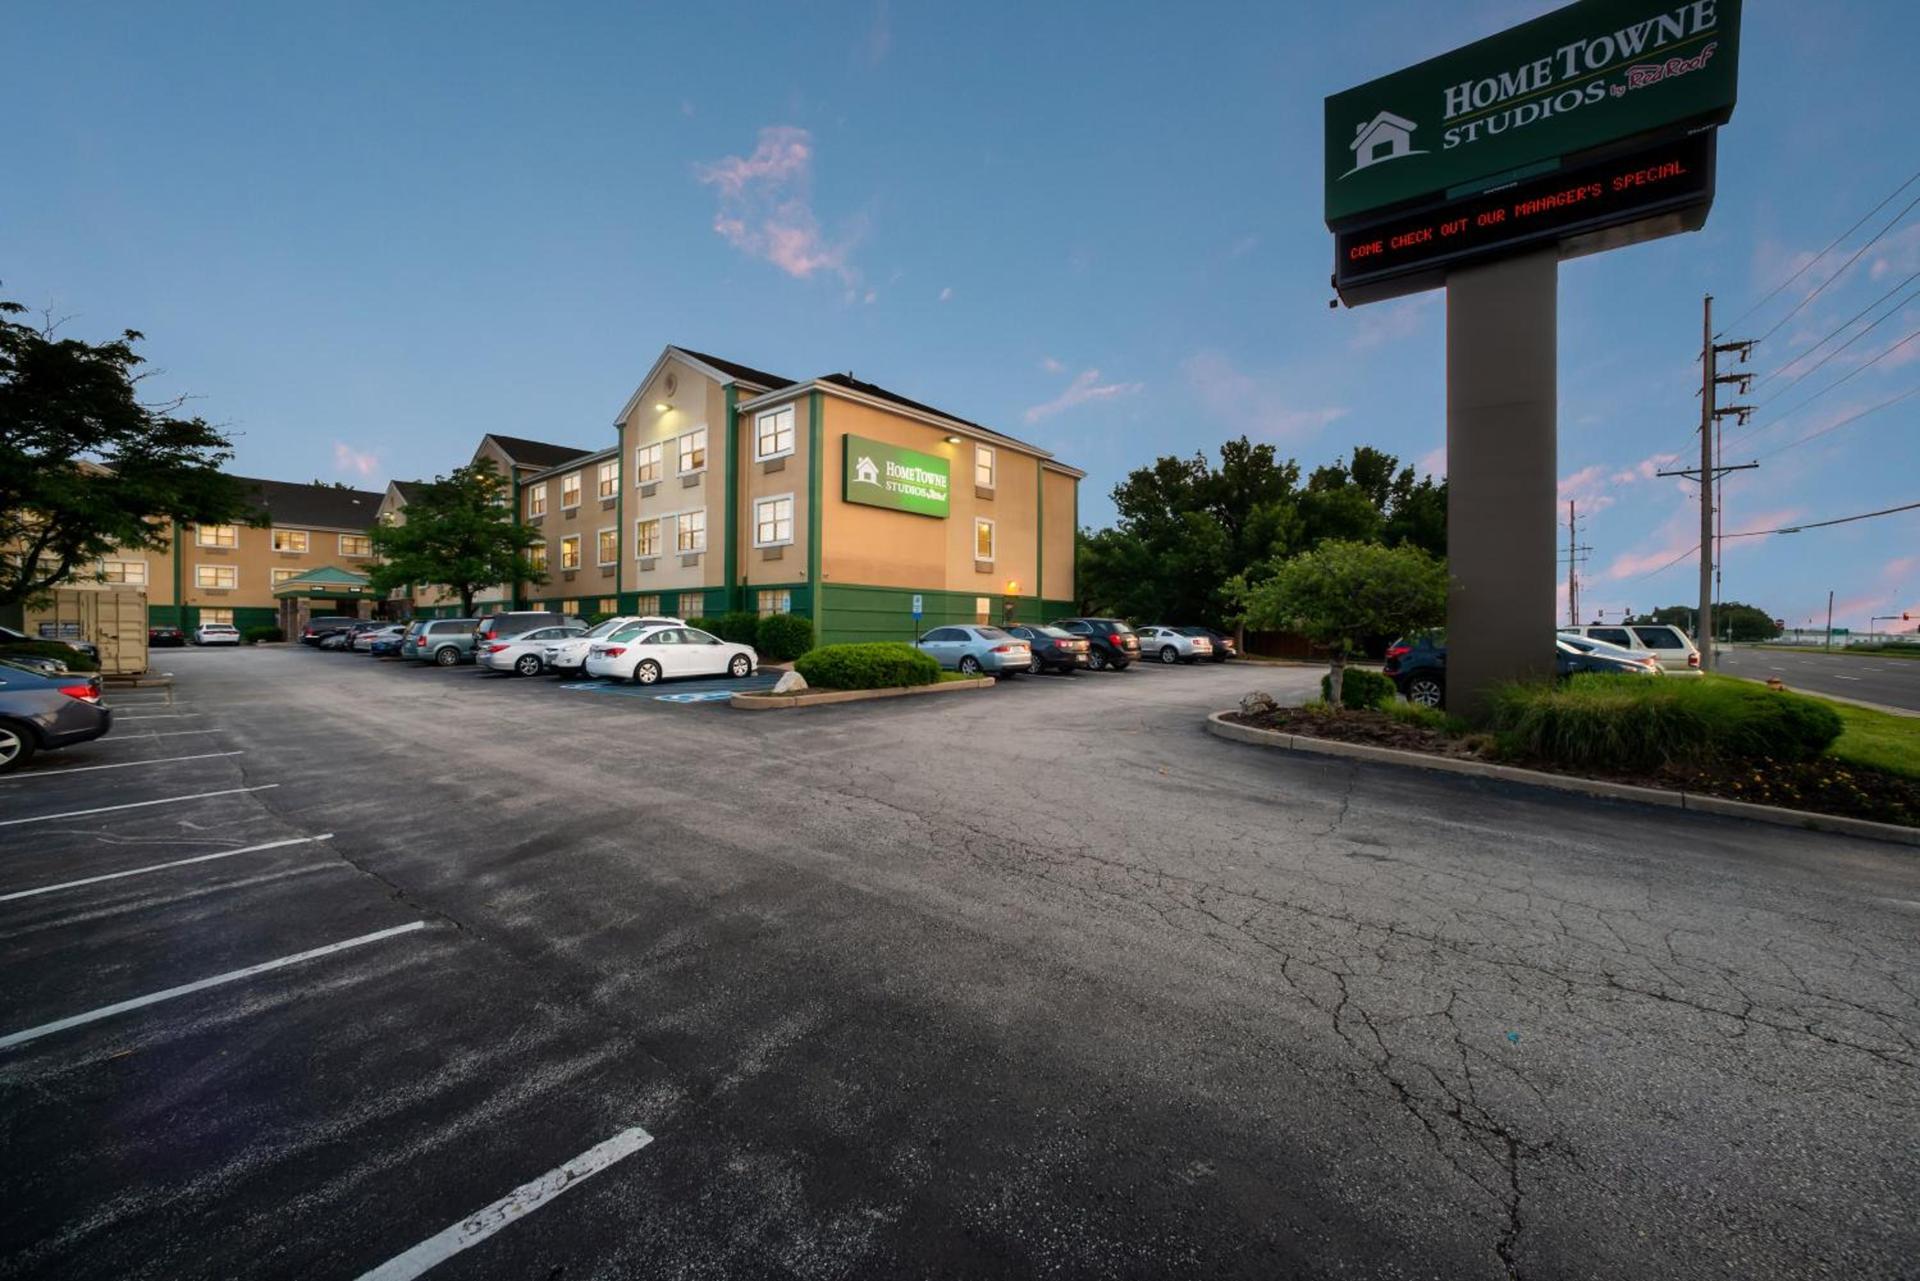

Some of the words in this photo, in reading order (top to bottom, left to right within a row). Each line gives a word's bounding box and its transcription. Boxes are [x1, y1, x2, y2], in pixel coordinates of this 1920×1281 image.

[1443, 79, 1606, 150] STUDIOS
[1609, 83, 1626, 98] by
[1625, 64, 1665, 90] Red
[1664, 41, 1718, 78] Roof
[1350, 241, 1384, 260] COME
[1391, 228, 1433, 249] CHECK
[1440, 217, 1469, 237] OUT
[1477, 208, 1506, 227] OUR
[1514, 182, 1603, 218] MANAGER'S
[1612, 160, 1687, 192] SPECIAL
[886, 480, 928, 498] STUDIOS
